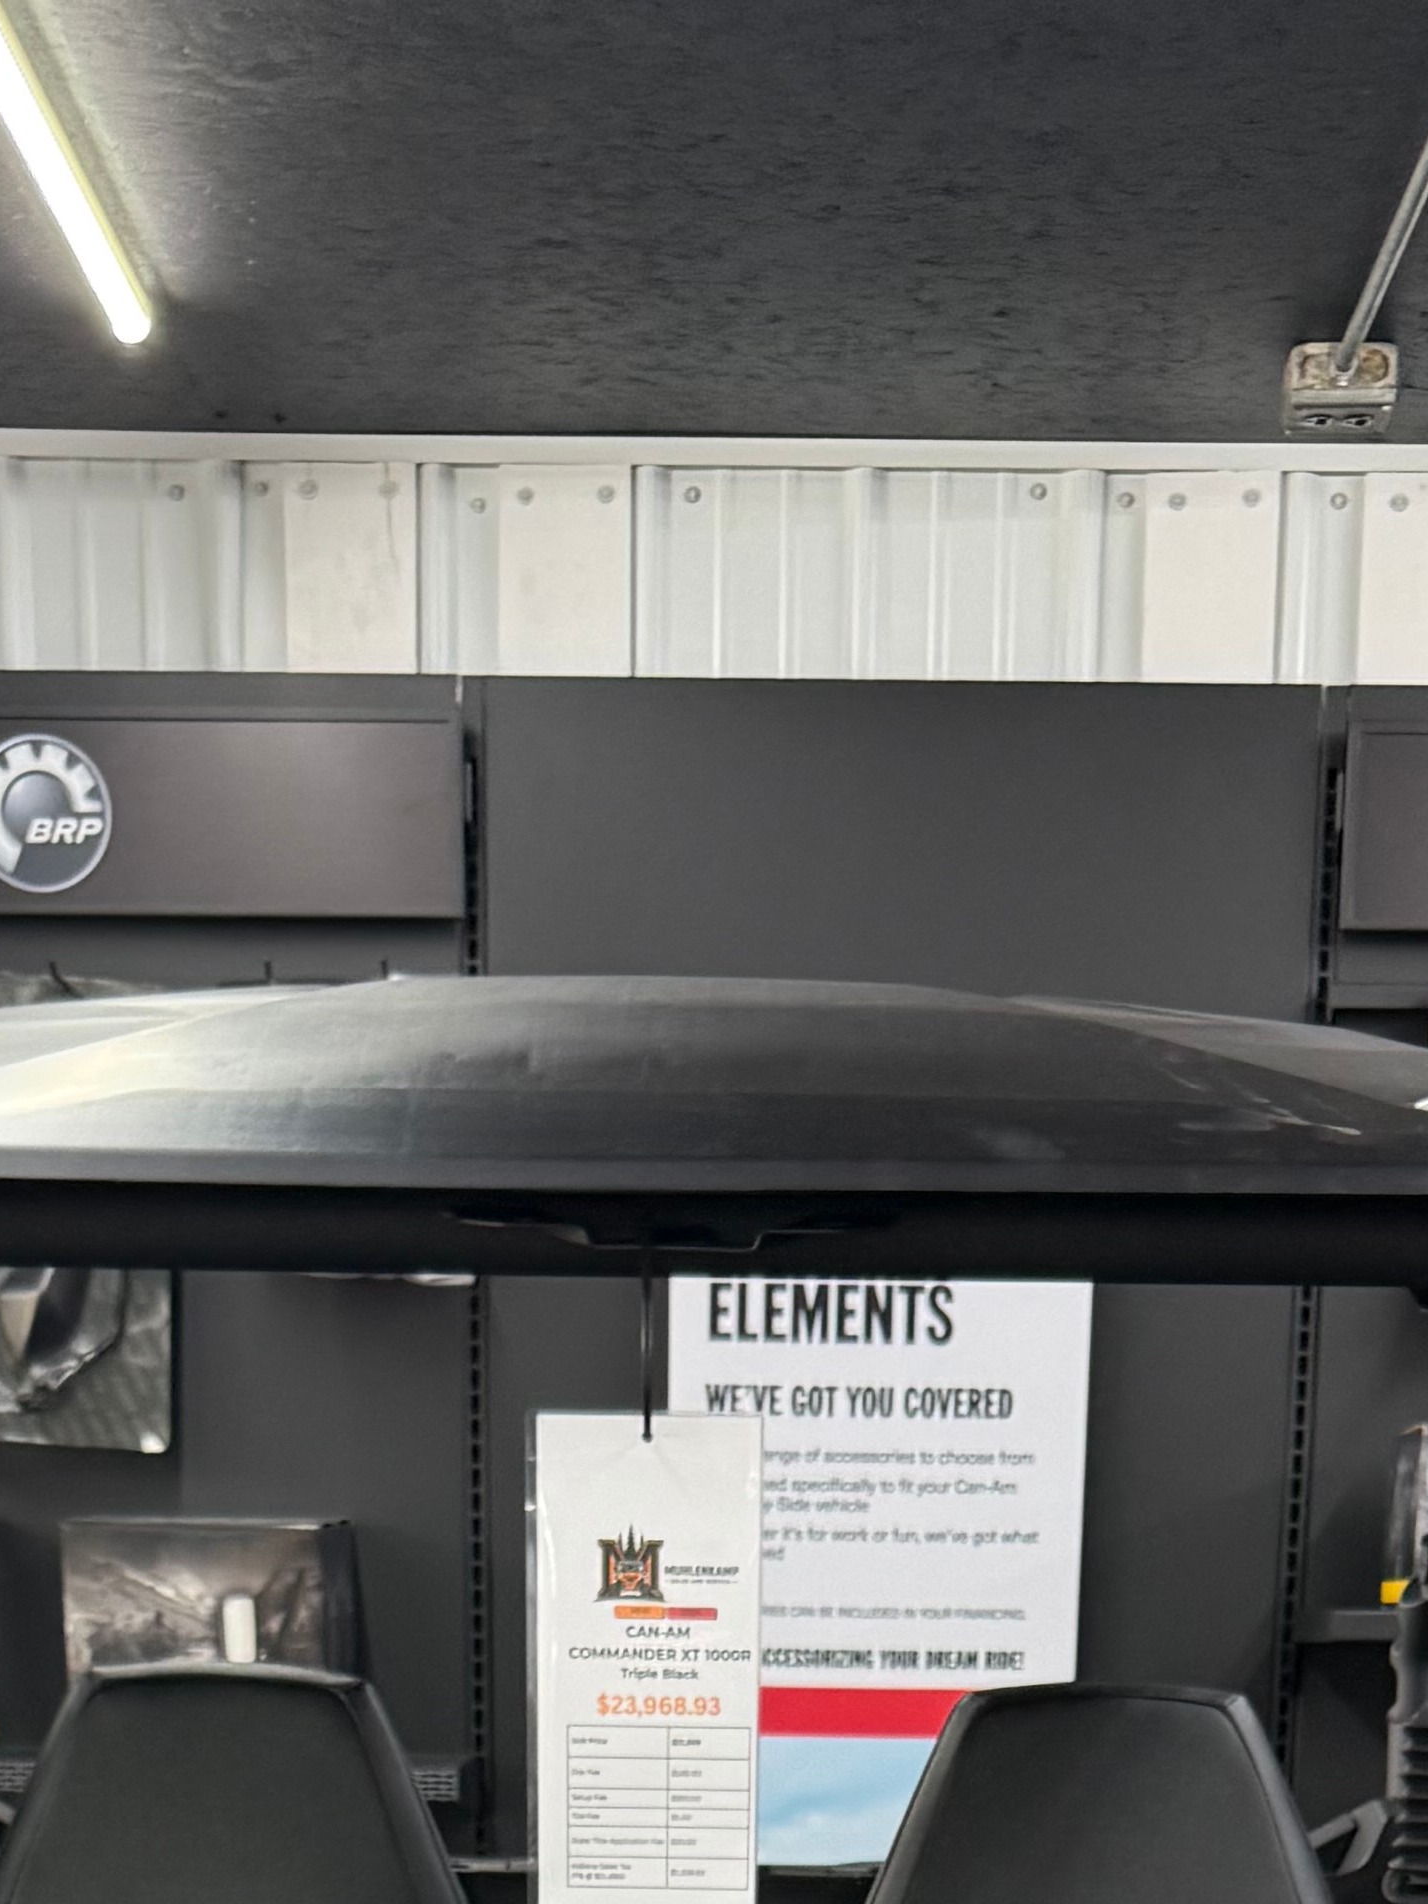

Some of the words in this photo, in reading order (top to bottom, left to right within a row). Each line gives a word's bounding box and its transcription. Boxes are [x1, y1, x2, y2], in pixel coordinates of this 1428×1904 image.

[25, 816, 104, 846] BRP
[708, 1282, 955, 1346] ELEMENTS
[705, 1383, 783, 1416] WE'VE
[790, 1384, 839, 1418] GOT
[845, 1385, 895, 1419] YOU
[903, 1387, 1014, 1420] COVERED
[919, 1452, 934, 1464] to
[938, 1451, 994, 1465] choose
[879, 1480, 895, 1493] to
[625, 1626, 691, 1640] CAN-AM
[568, 1647, 677, 1662] COMMANDER
[681, 1648, 700, 1662] XT
[704, 1649, 751, 1662] 1000R
[762, 1647, 873, 1668] CCESSORIZING
[620, 1667, 658, 1681] Triple
[662, 1668, 699, 1681] Black
[596, 1692, 722, 1718] $23,968.93
